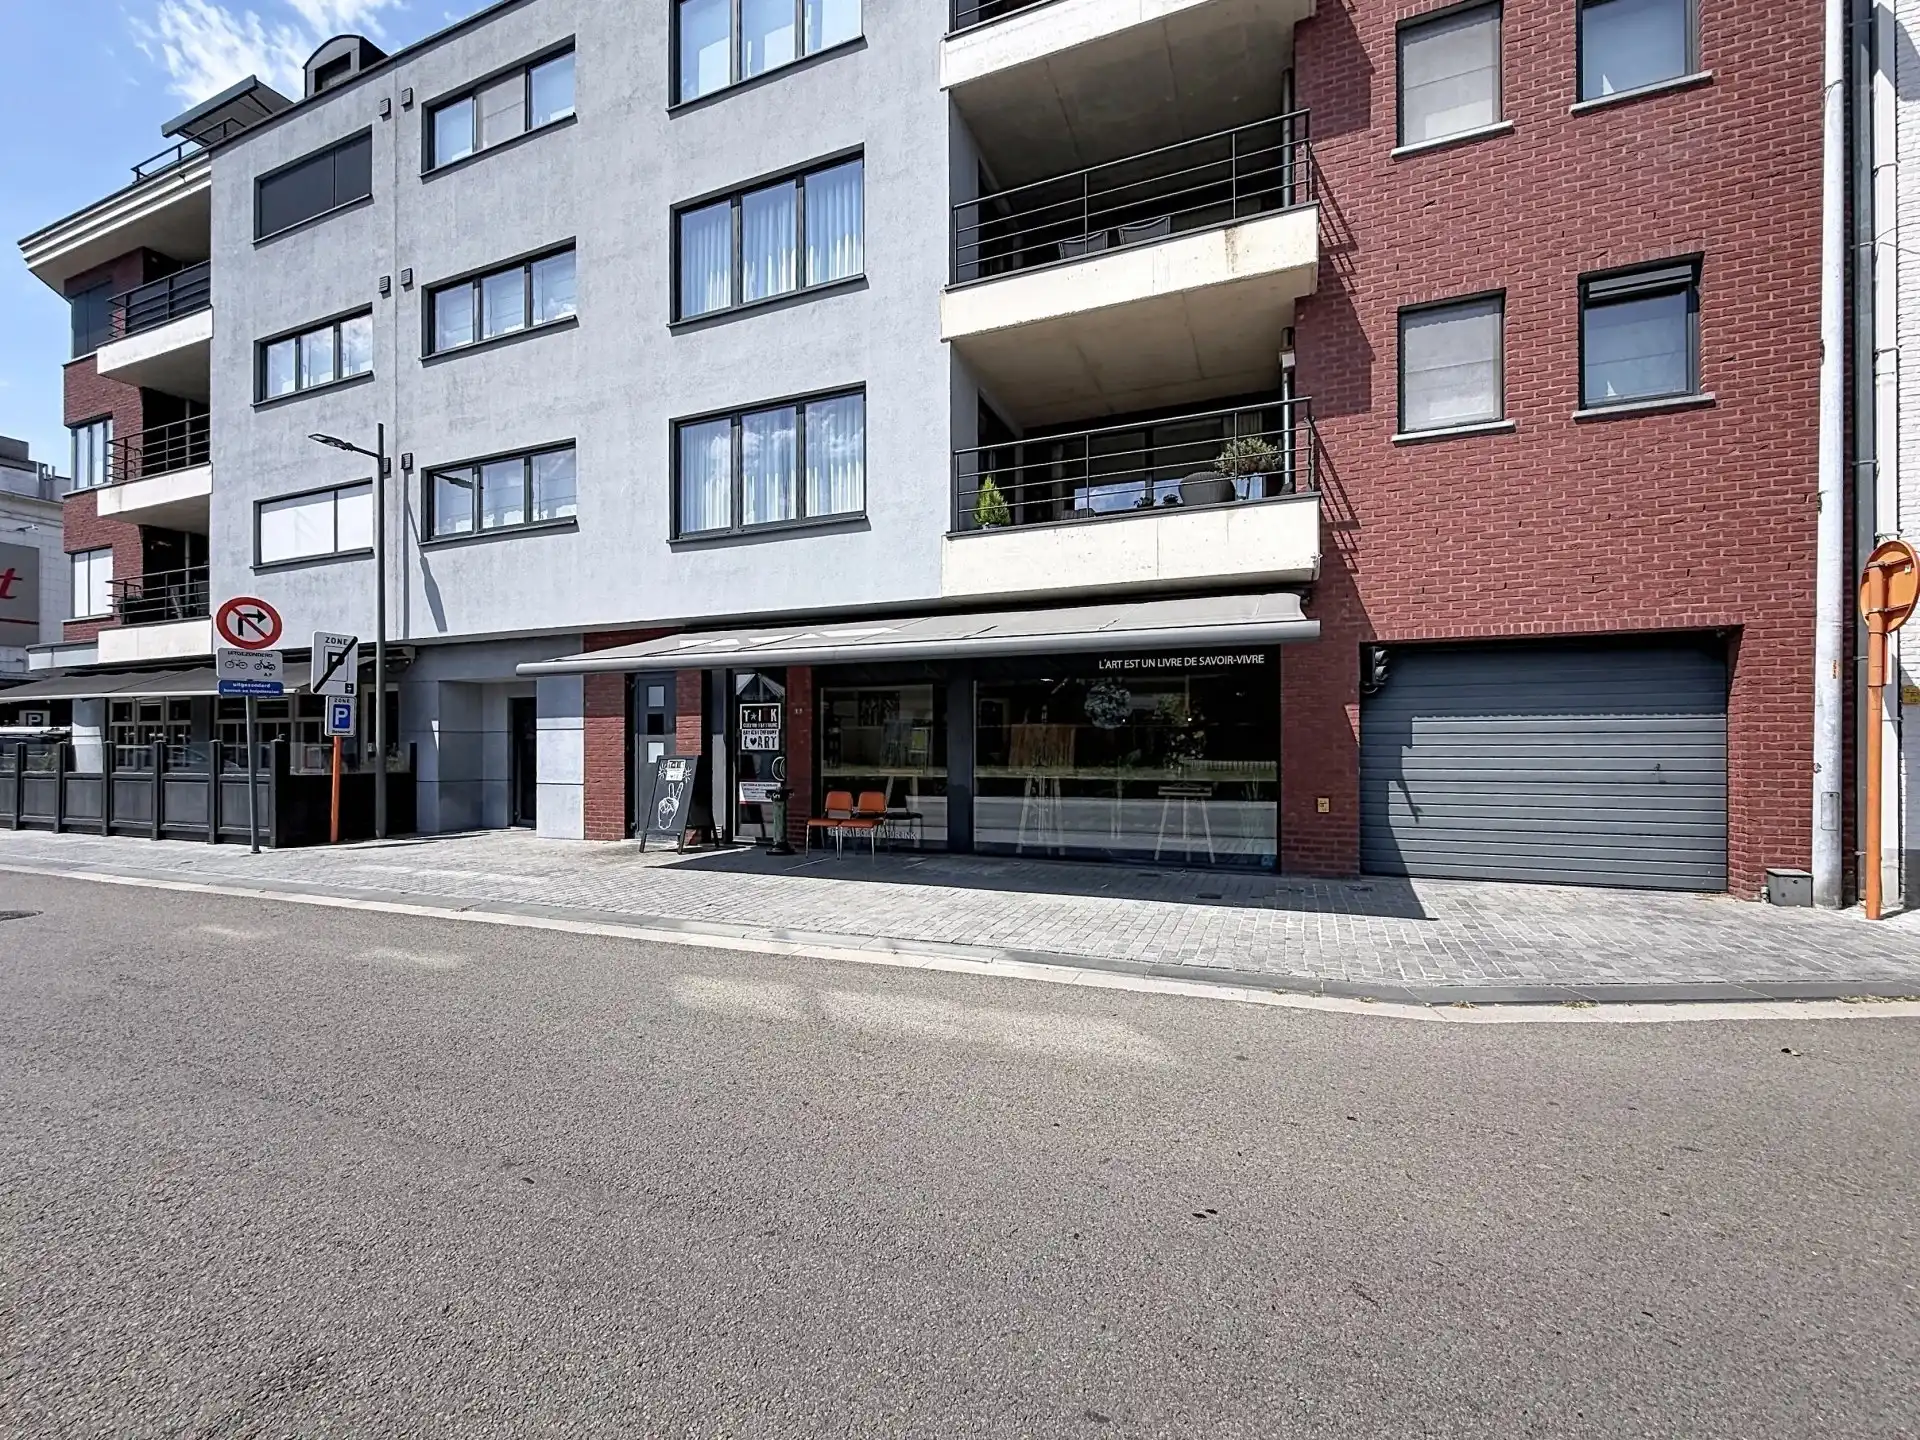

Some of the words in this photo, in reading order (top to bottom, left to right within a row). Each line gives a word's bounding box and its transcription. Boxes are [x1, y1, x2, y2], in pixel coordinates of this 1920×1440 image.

[325, 636, 349, 646] ZONE
[1099, 658, 1122, 669] L'ART
[1124, 659, 1140, 668] EST
[1141, 658, 1155, 668] UN
[1157, 657, 1182, 667] LIVRE
[1184, 656, 1197, 666] DE
[1199, 654, 1264, 666] SAVOIR-VIVRE
[334, 707, 349, 726] P
